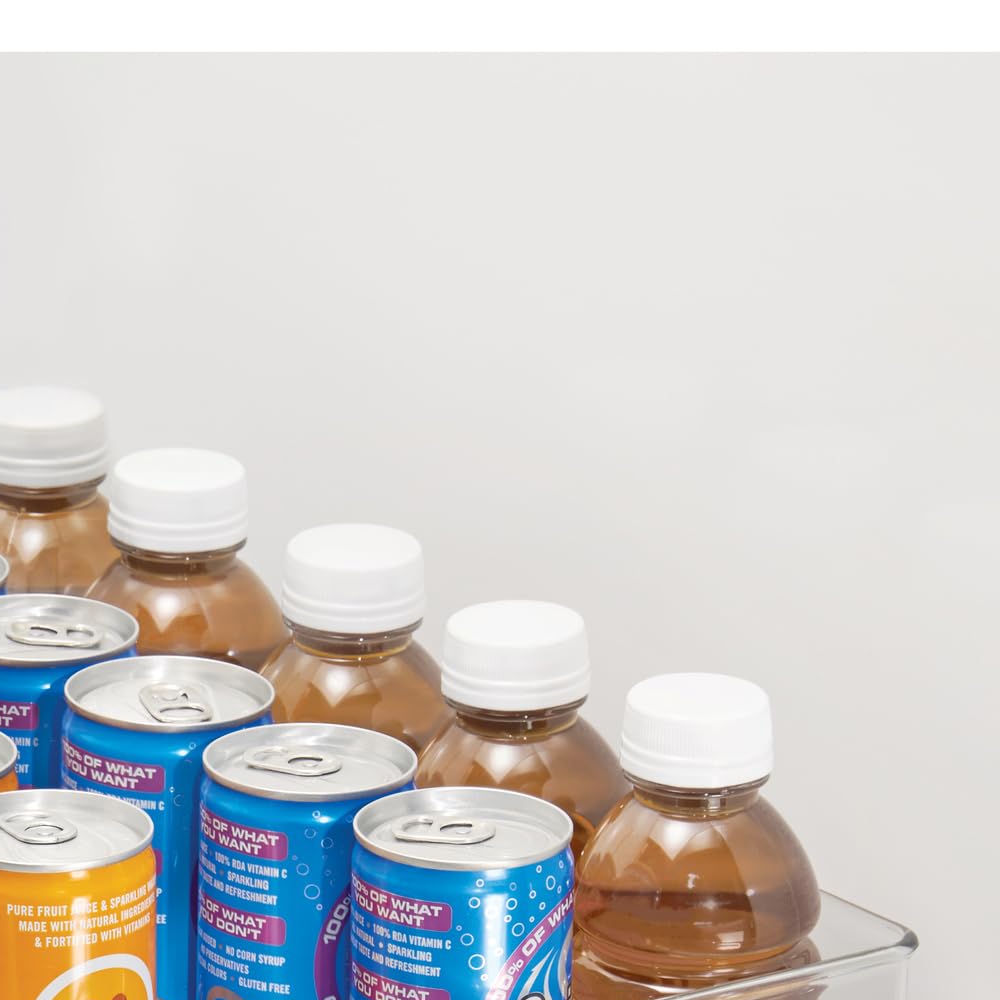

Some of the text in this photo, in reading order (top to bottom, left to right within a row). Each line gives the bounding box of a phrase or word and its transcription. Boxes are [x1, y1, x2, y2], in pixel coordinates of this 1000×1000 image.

[84, 756, 157, 780] OF WHAT
[91, 770, 139, 789] WANT
[212, 818, 279, 846] OF WHAT
[218, 833, 262, 855] WANT
[227, 871, 269, 890] SPARKLING
[247, 863, 280, 878] VITAMIN
[225, 884, 278, 905] REFRESHMENT
[370, 889, 442, 917] OF WHAT
[7, 903, 68, 917] PURE FRUIT
[205, 899, 266, 929] OF WHAT
[354, 889, 424, 927] YOU WANT
[19, 912, 118, 932] MADE WITH NATURAL
[216, 917, 262, 940] DON'T
[35, 927, 122, 948] & WITH
[392, 930, 443, 950] RDA VITAMIN
[522, 926, 546, 957] OF
[236, 949, 286, 967] CORN SYRUP
[387, 943, 432, 962] SPARKLING
[385, 957, 441, 977] REFRESHMENT
[238, 976, 291, 995] GLUTEN FREE
[363, 972, 379, 987] OF
